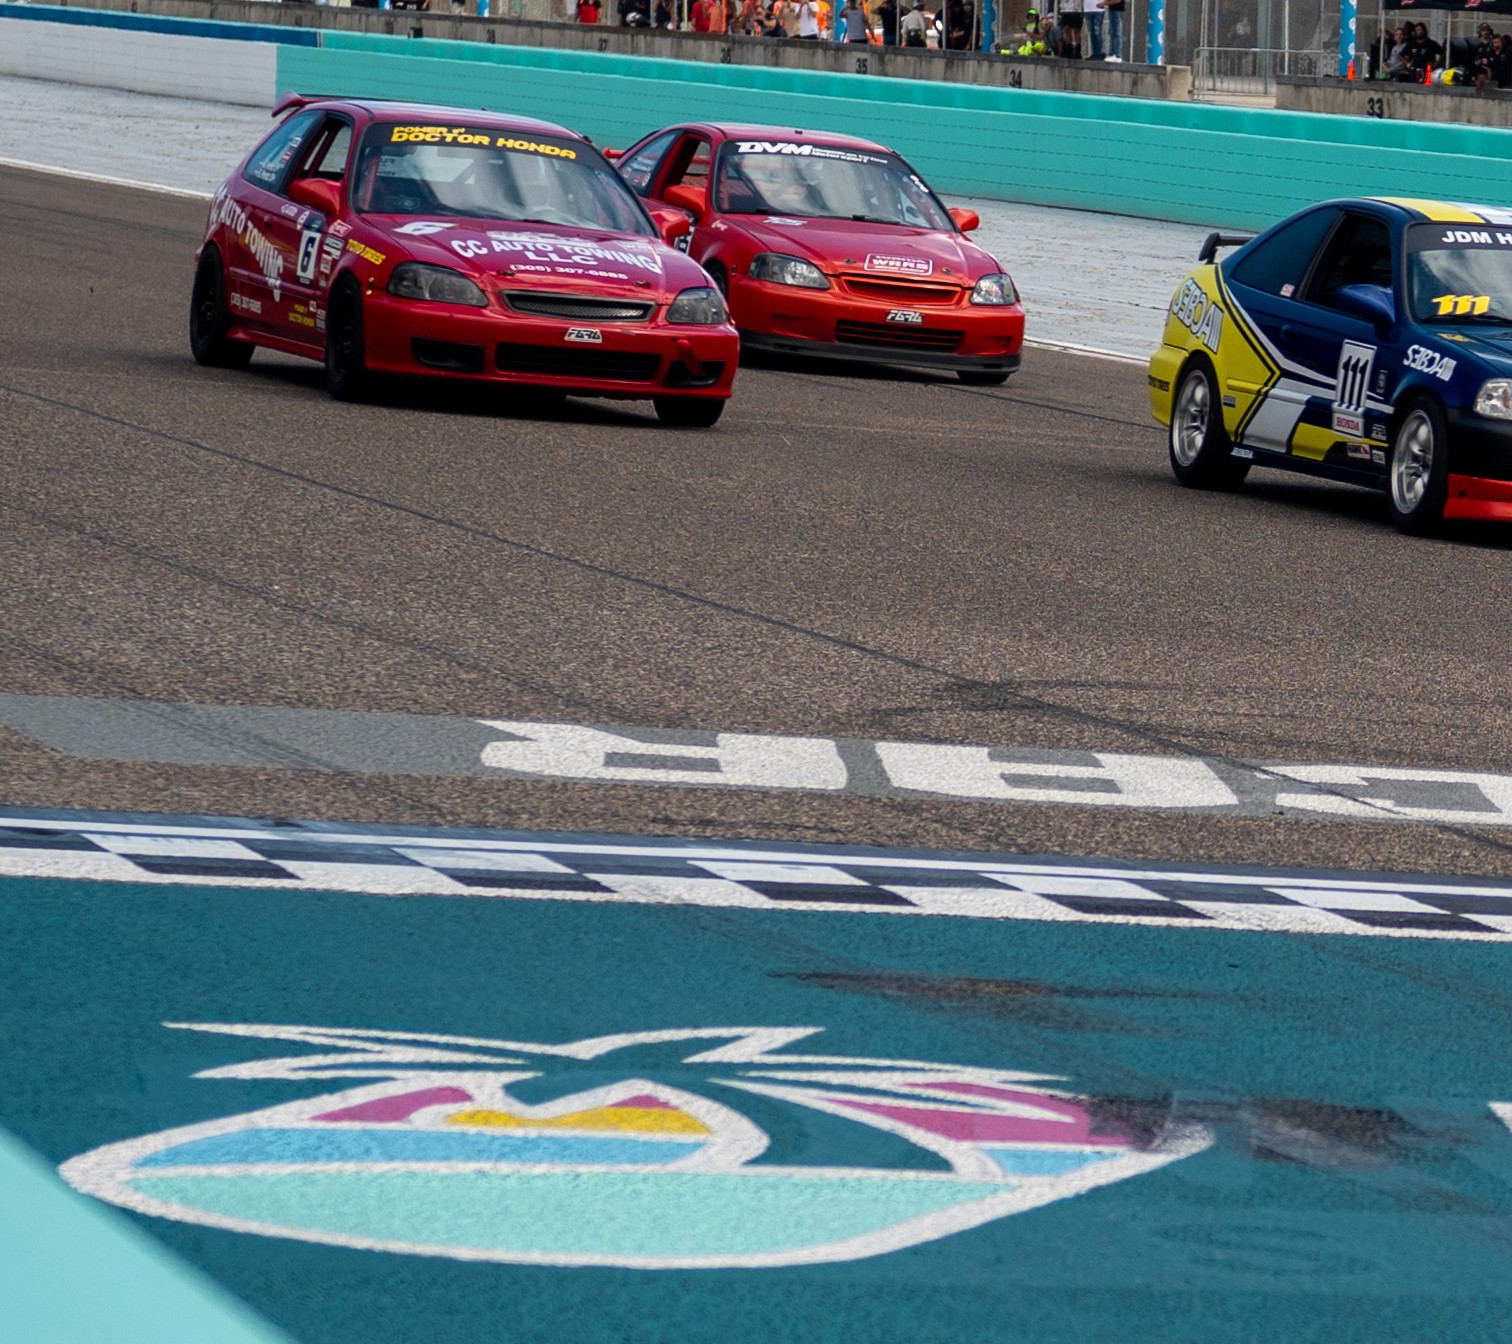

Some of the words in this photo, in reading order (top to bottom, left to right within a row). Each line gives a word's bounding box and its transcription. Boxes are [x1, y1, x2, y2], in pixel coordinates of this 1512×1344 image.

[856, 58, 868, 75] 35
[1009, 69, 1022, 89] 34
[1367, 97, 1384, 119] 33
[392, 126, 448, 134] POWER
[390, 132, 491, 146] DOCTOR
[496, 138, 577, 160] HONDA
[735, 141, 813, 156] DVM
[218, 195, 246, 235] AUTO
[1442, 230, 1492, 244] JDM
[300, 236, 317, 274] 6
[450, 239, 488, 258] CC
[491, 240, 554, 253] AUTO
[556, 244, 663, 275] TOWING
[524, 251, 599, 266] LLC
[872, 258, 929, 270] WARS
[1432, 294, 1492, 316] 111
[1337, 355, 1370, 412] 111
